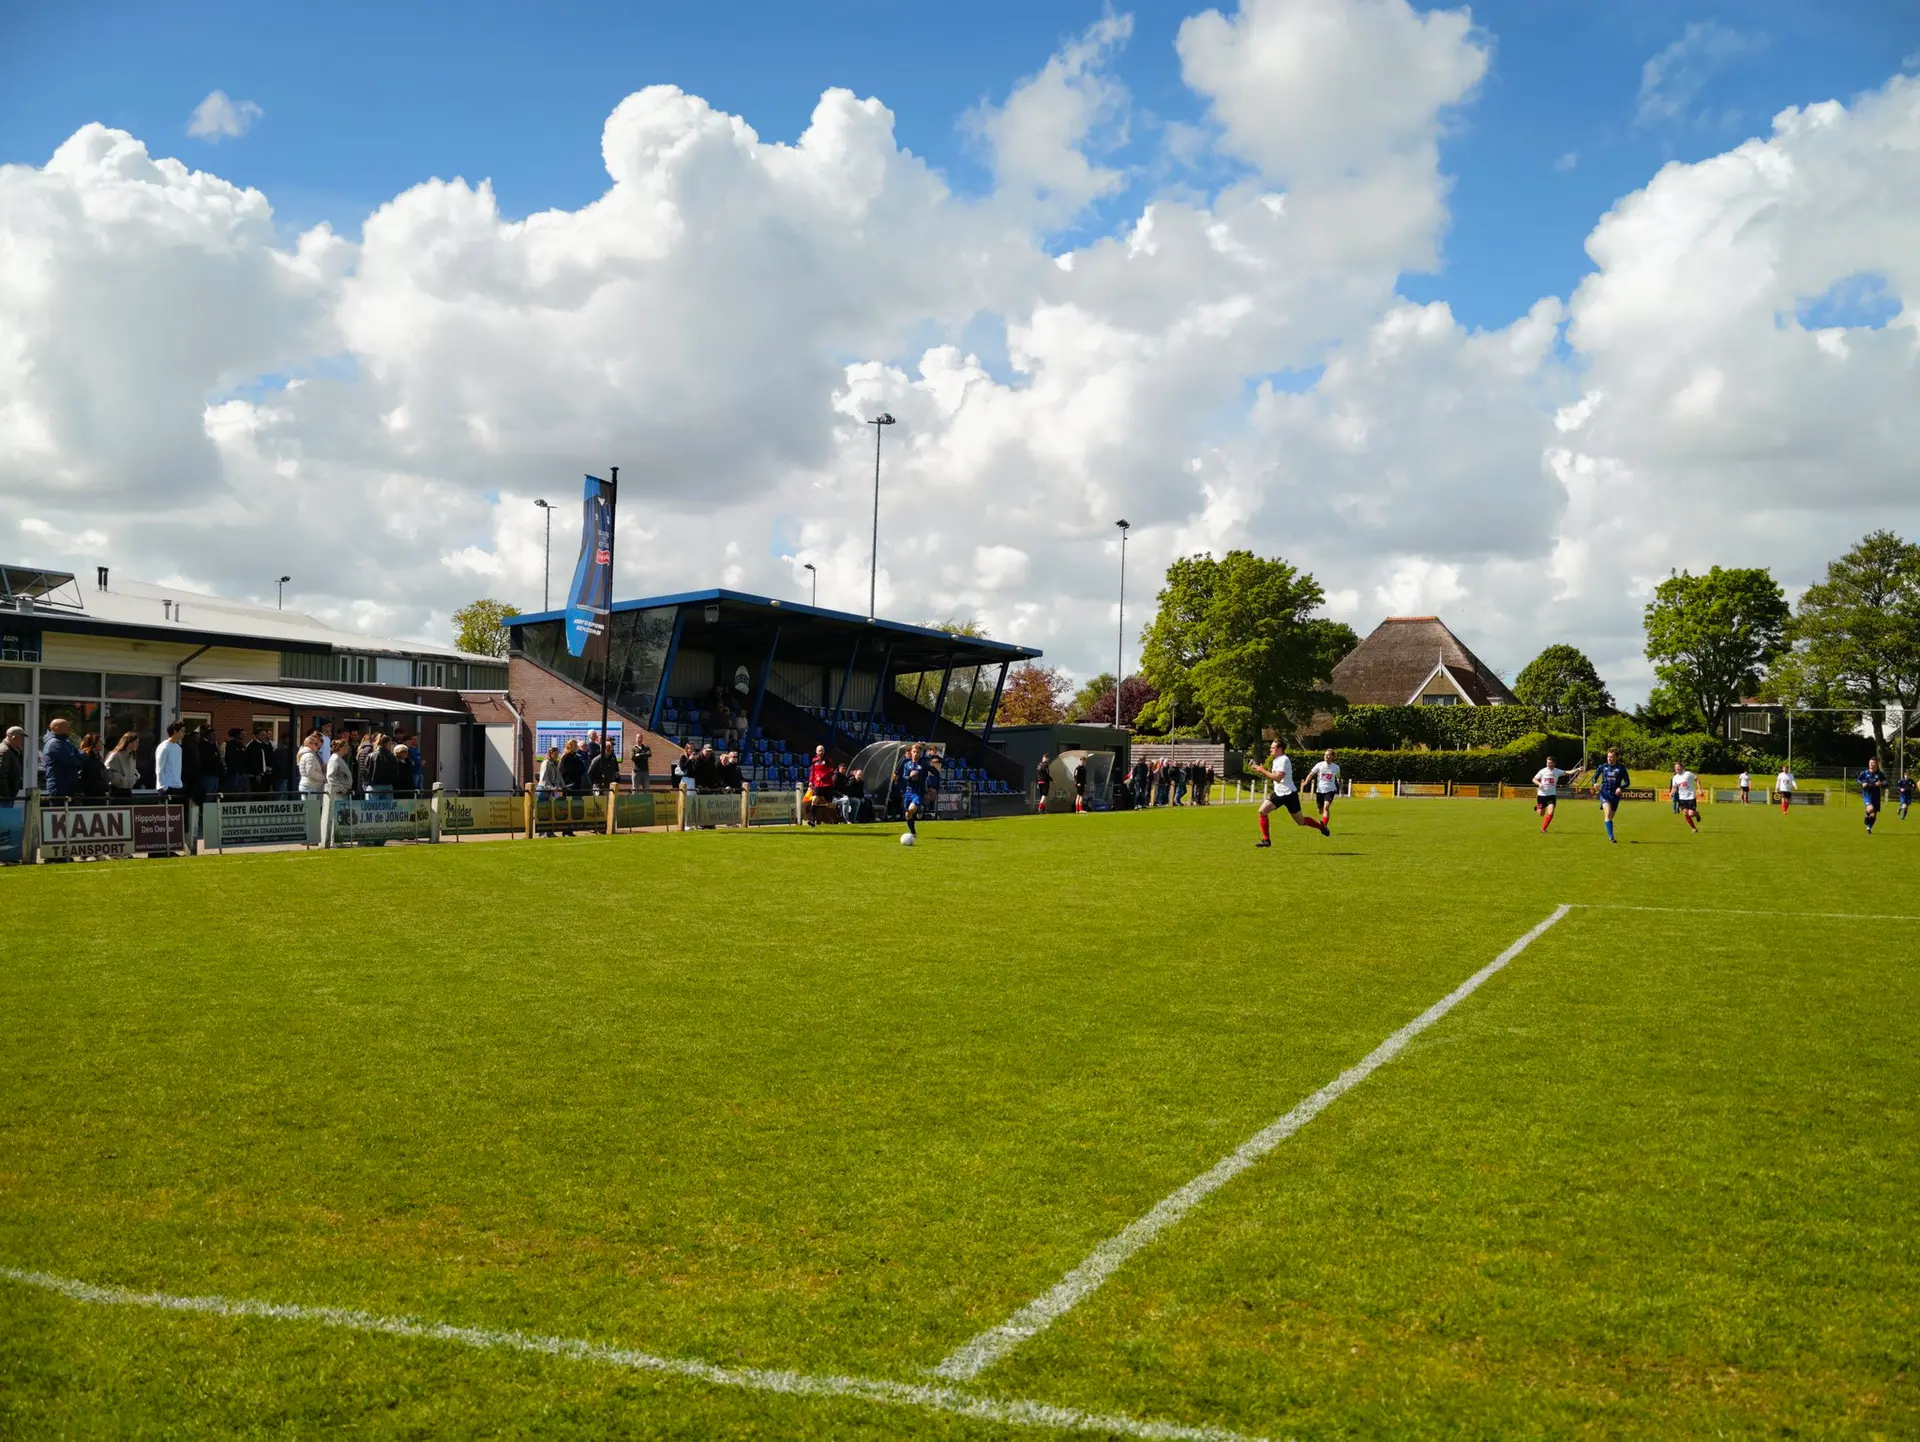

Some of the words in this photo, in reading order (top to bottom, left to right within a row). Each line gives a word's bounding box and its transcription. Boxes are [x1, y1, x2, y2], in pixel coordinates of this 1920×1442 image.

[222, 805, 247, 815] NISTE
[249, 804, 291, 814] MONTAGE
[293, 803, 304, 813] BV
[375, 812, 384, 823] de
[51, 812, 124, 839] KAAN
[141, 826, 154, 834] Den
[252, 827, 259, 835] IN
